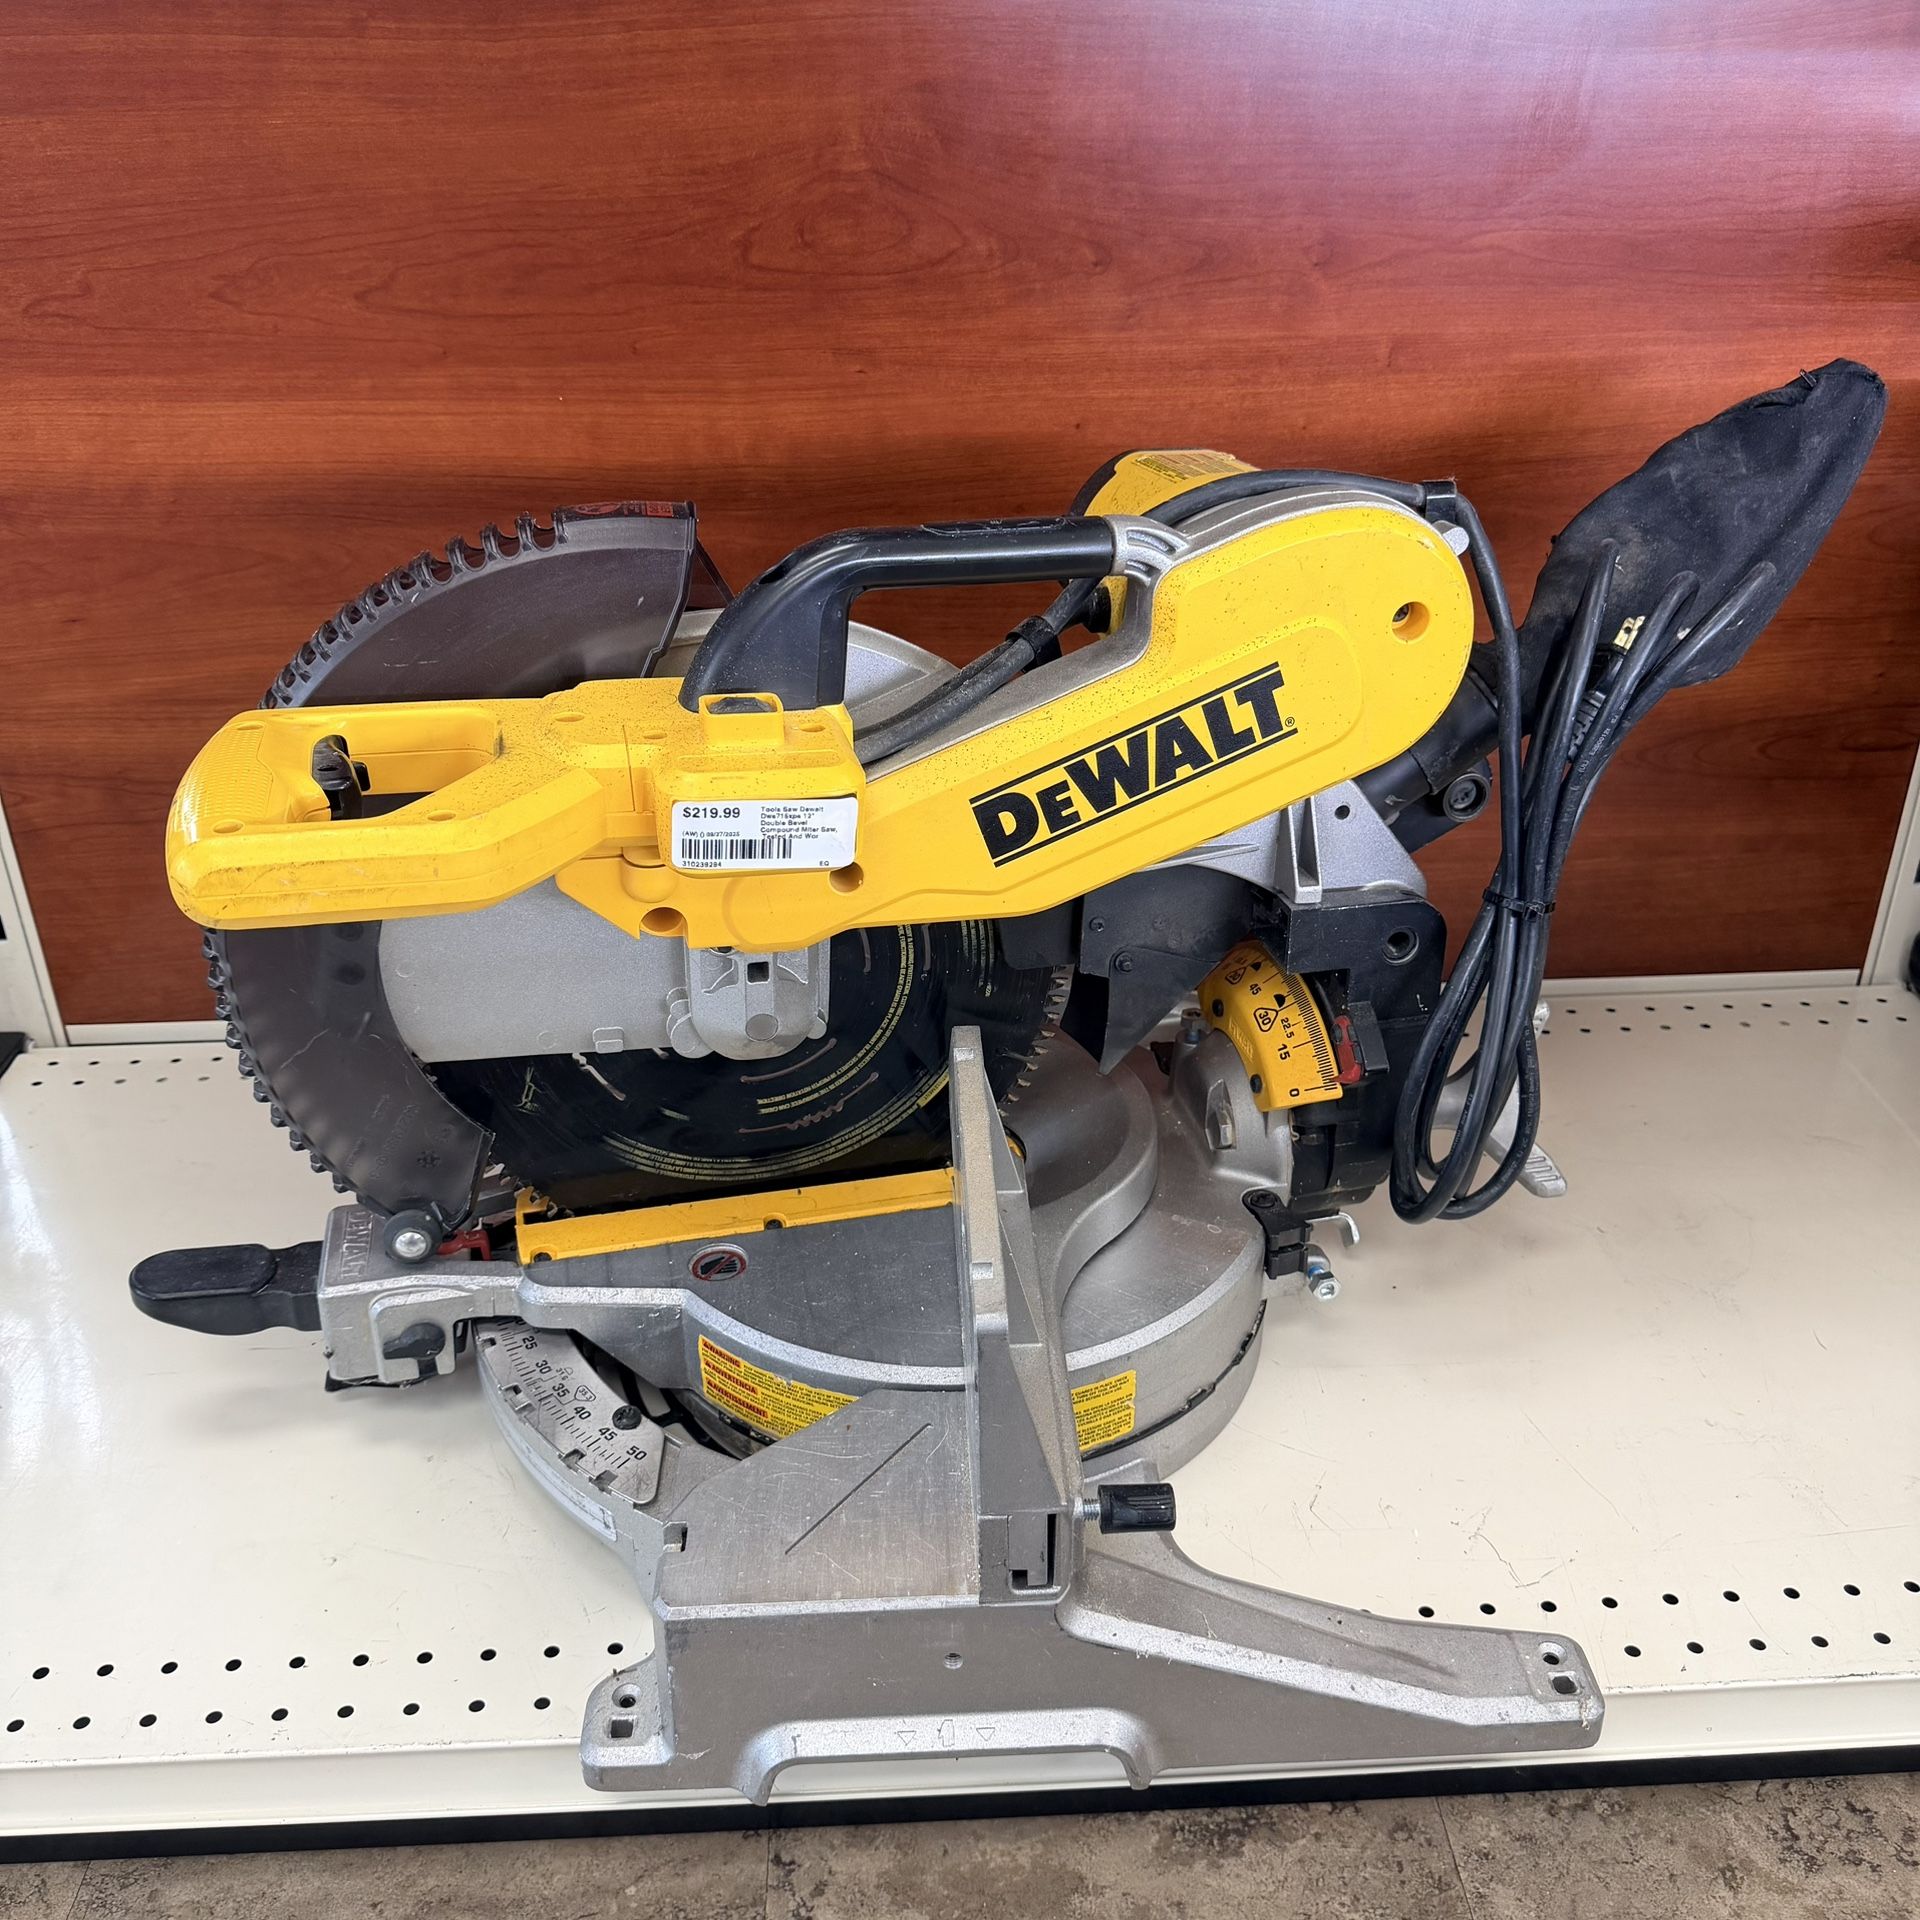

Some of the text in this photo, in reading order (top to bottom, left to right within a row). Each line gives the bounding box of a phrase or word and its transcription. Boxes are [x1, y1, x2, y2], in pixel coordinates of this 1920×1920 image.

[682, 806, 741, 819] $219.99
[1249, 983, 1262, 996] 45
[1258, 1010, 1272, 1027] 30
[1281, 1017, 1295, 1039] 22.5
[1277, 1043, 1291, 1060] 15
[1289, 1088, 1300, 1098] 0
[522, 1335, 538, 1350] 25
[711, 1344, 741, 1367] WARNING
[535, 1359, 553, 1375] 30
[552, 1383, 570, 1398] 35
[573, 1405, 592, 1421] 40
[598, 1426, 618, 1441] 45
[626, 1445, 647, 1461] 50
